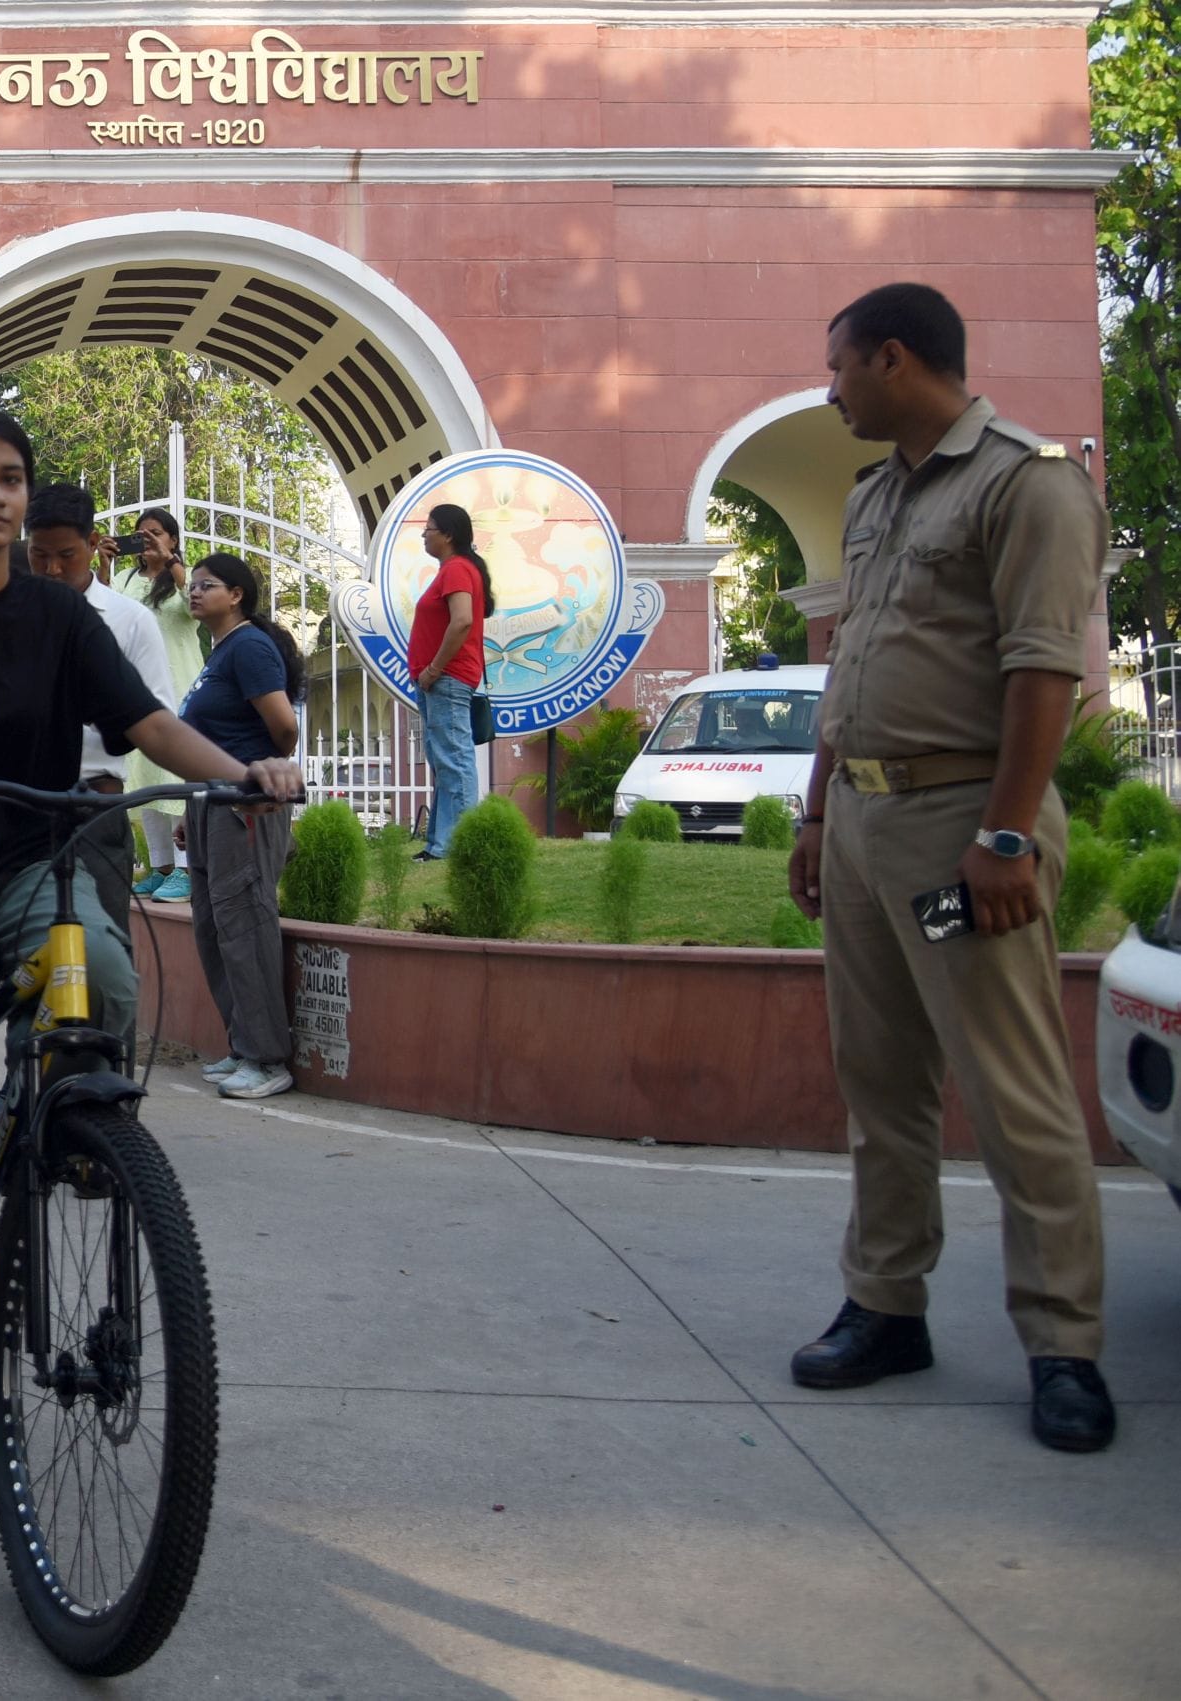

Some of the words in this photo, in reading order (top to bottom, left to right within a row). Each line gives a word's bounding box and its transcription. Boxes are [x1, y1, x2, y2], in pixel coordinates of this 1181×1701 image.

[86, 114, 185, 146] स्थापित
[505, 606, 556, 636] LEARNING
[497, 708, 527, 729] OF
[532, 648, 628, 725] LUCKNOW
[330, 1001, 346, 1015] BOYS
